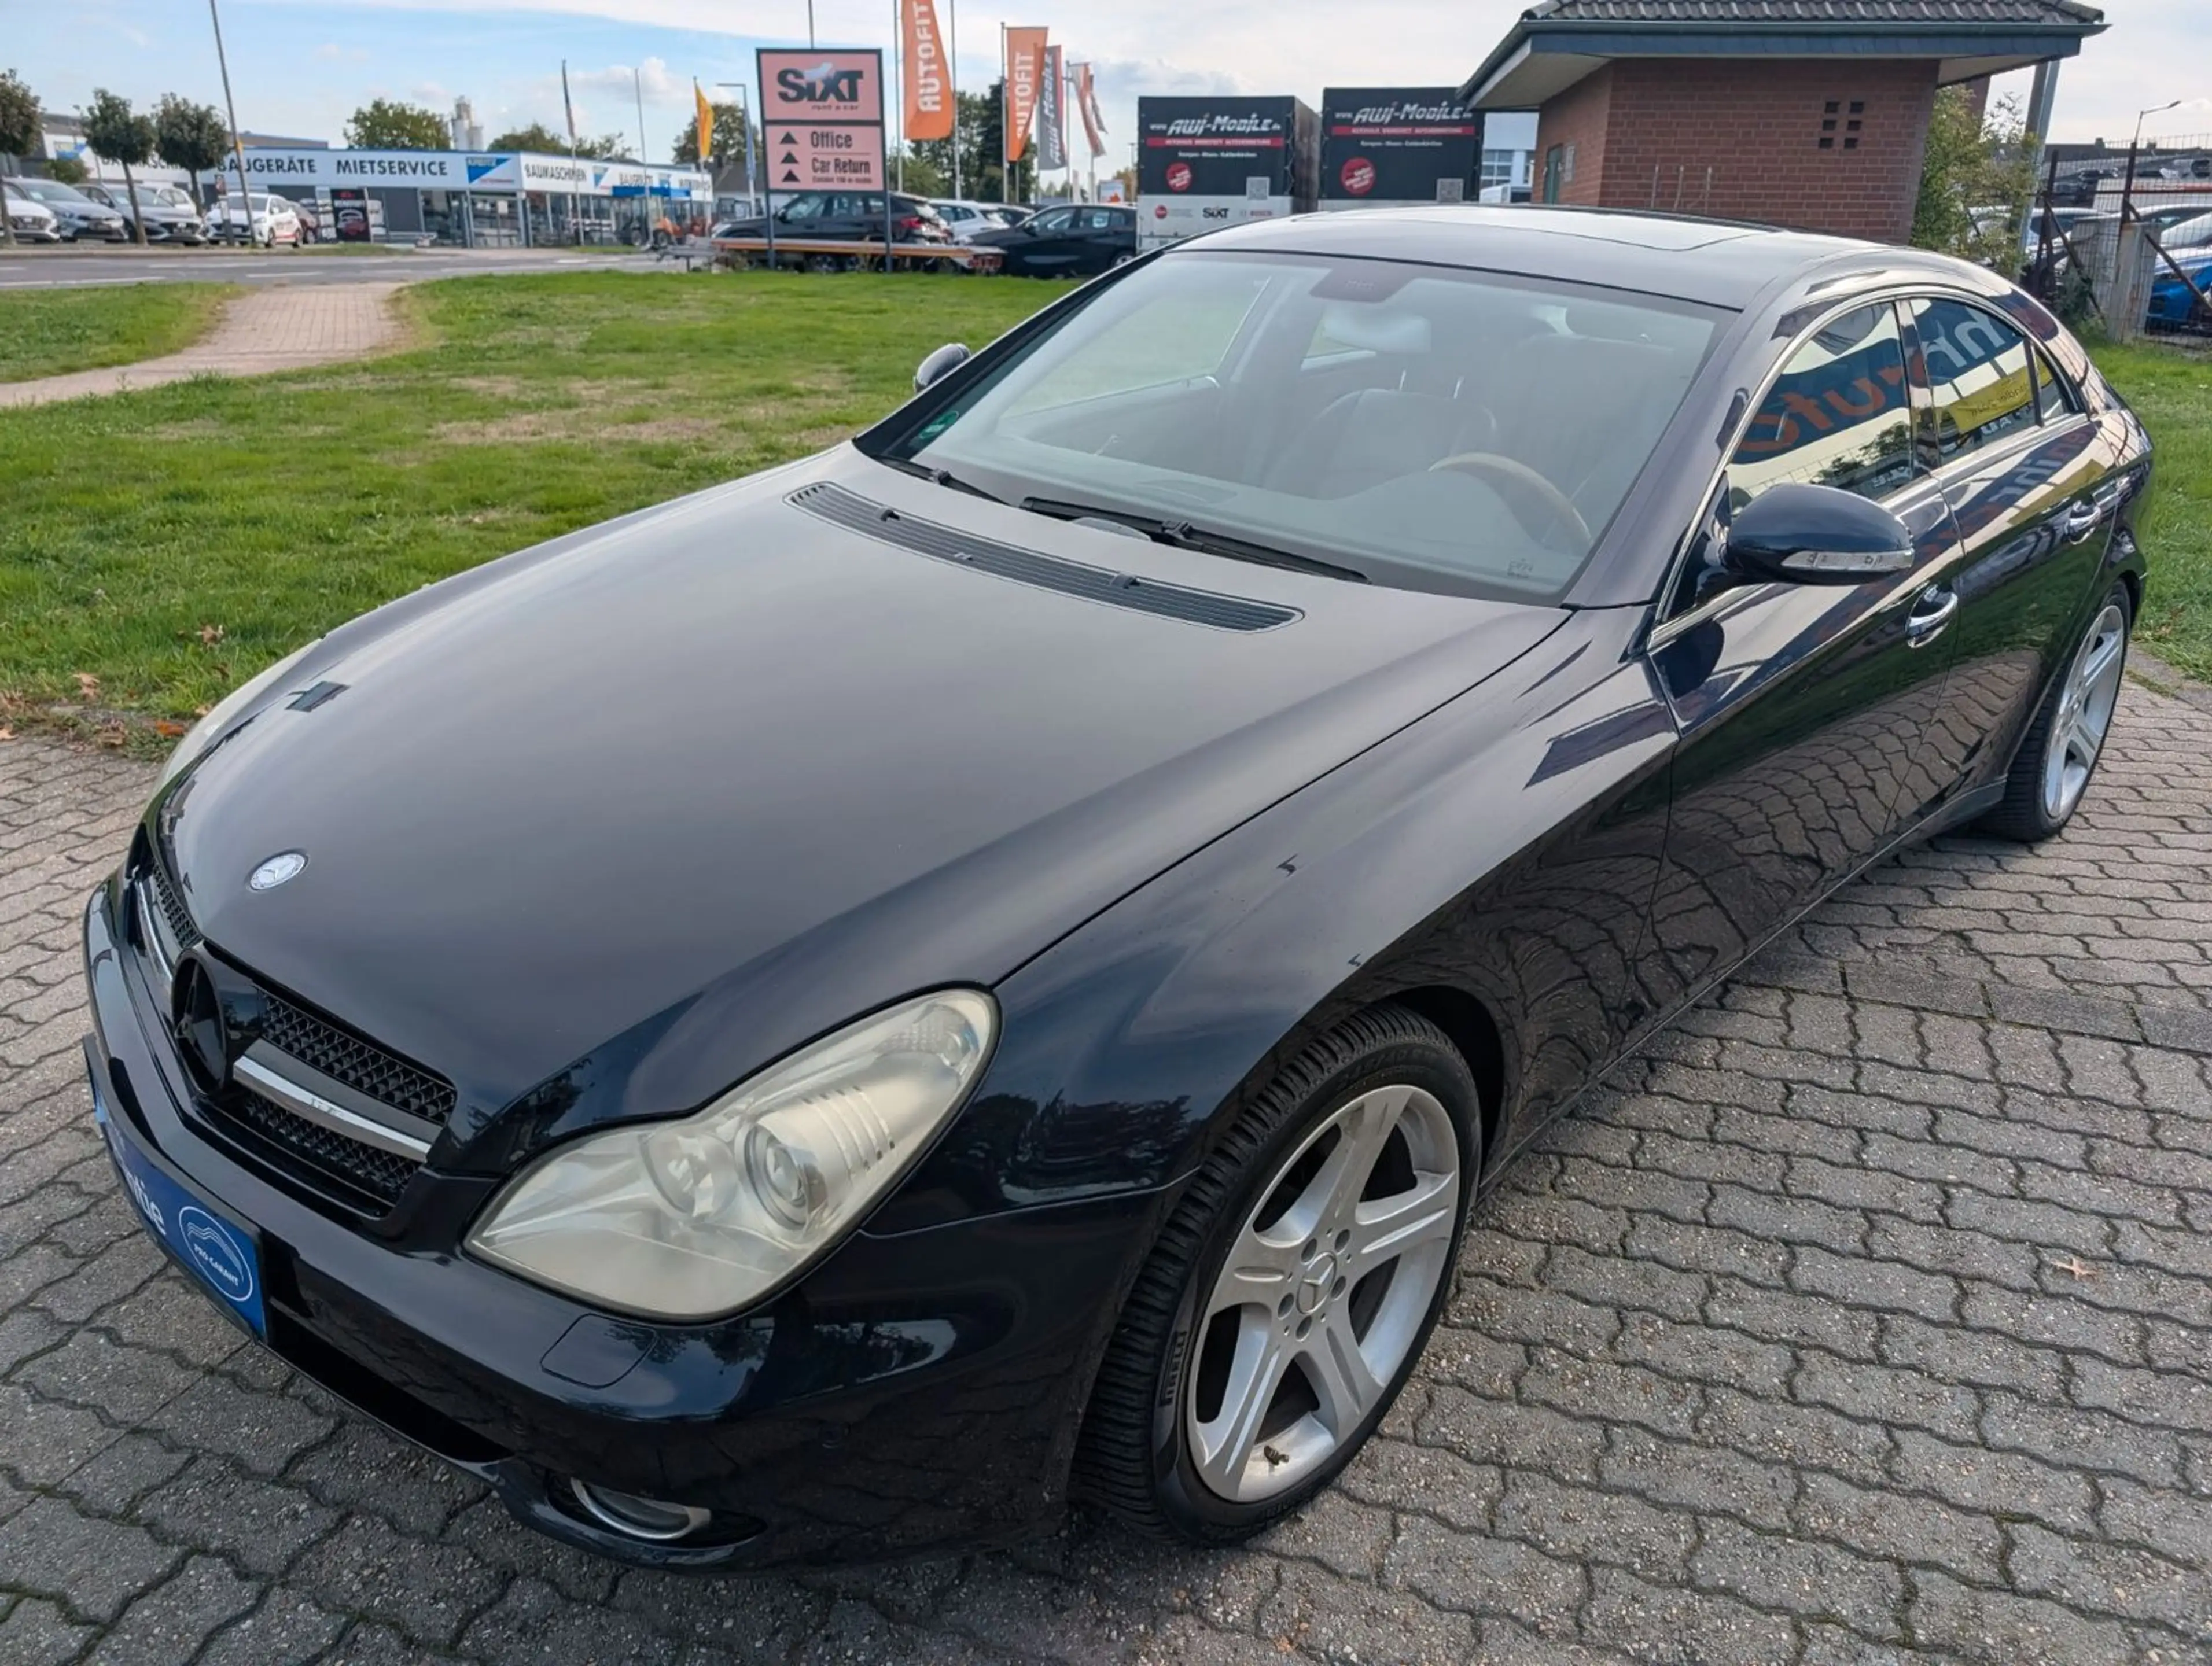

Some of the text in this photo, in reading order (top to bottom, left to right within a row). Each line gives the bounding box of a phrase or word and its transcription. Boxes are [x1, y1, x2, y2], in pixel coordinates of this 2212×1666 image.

[913, 1, 941, 112] AUTOFIT
[777, 68, 863, 102] SIXT
[811, 131, 853, 148] Office
[336, 159, 448, 176] MIETSERVICE
[812, 157, 871, 174] Car Return
